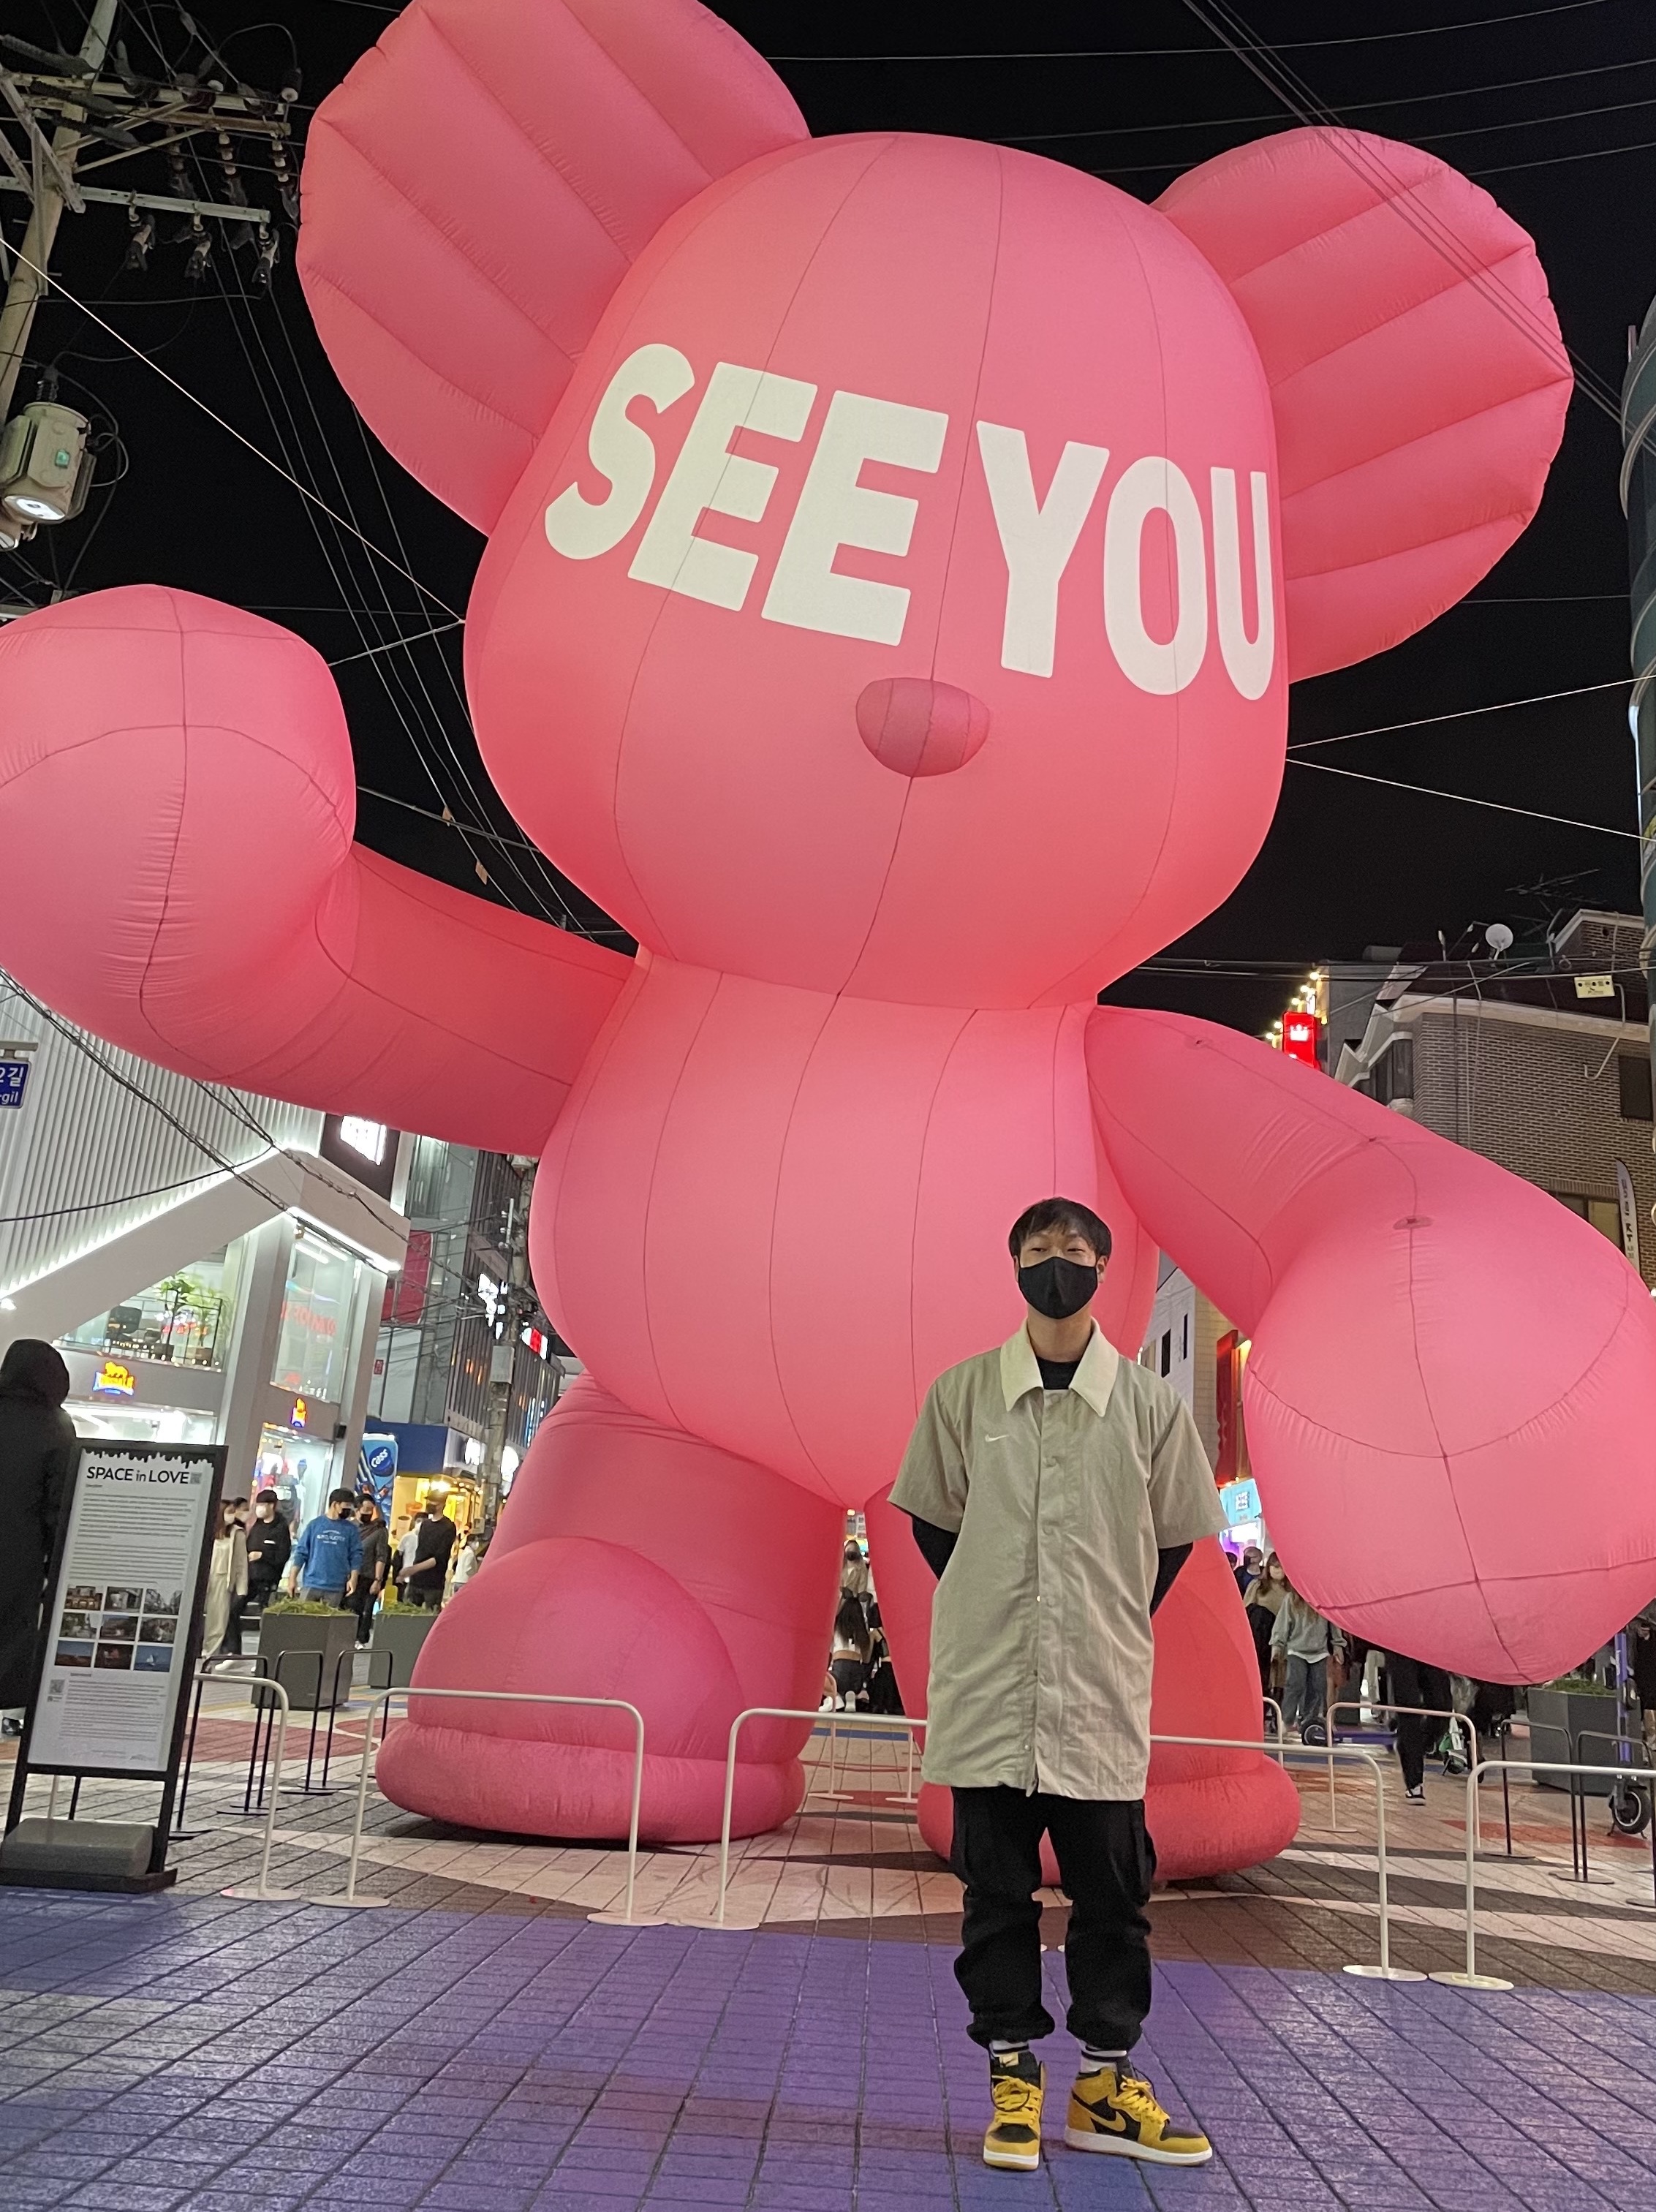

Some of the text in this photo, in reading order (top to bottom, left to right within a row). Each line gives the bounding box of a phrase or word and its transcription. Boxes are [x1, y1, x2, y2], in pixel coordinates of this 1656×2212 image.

[545, 343, 1275, 701] SEE YOU
[86, 1466, 189, 1484] SPACE in LOVE
